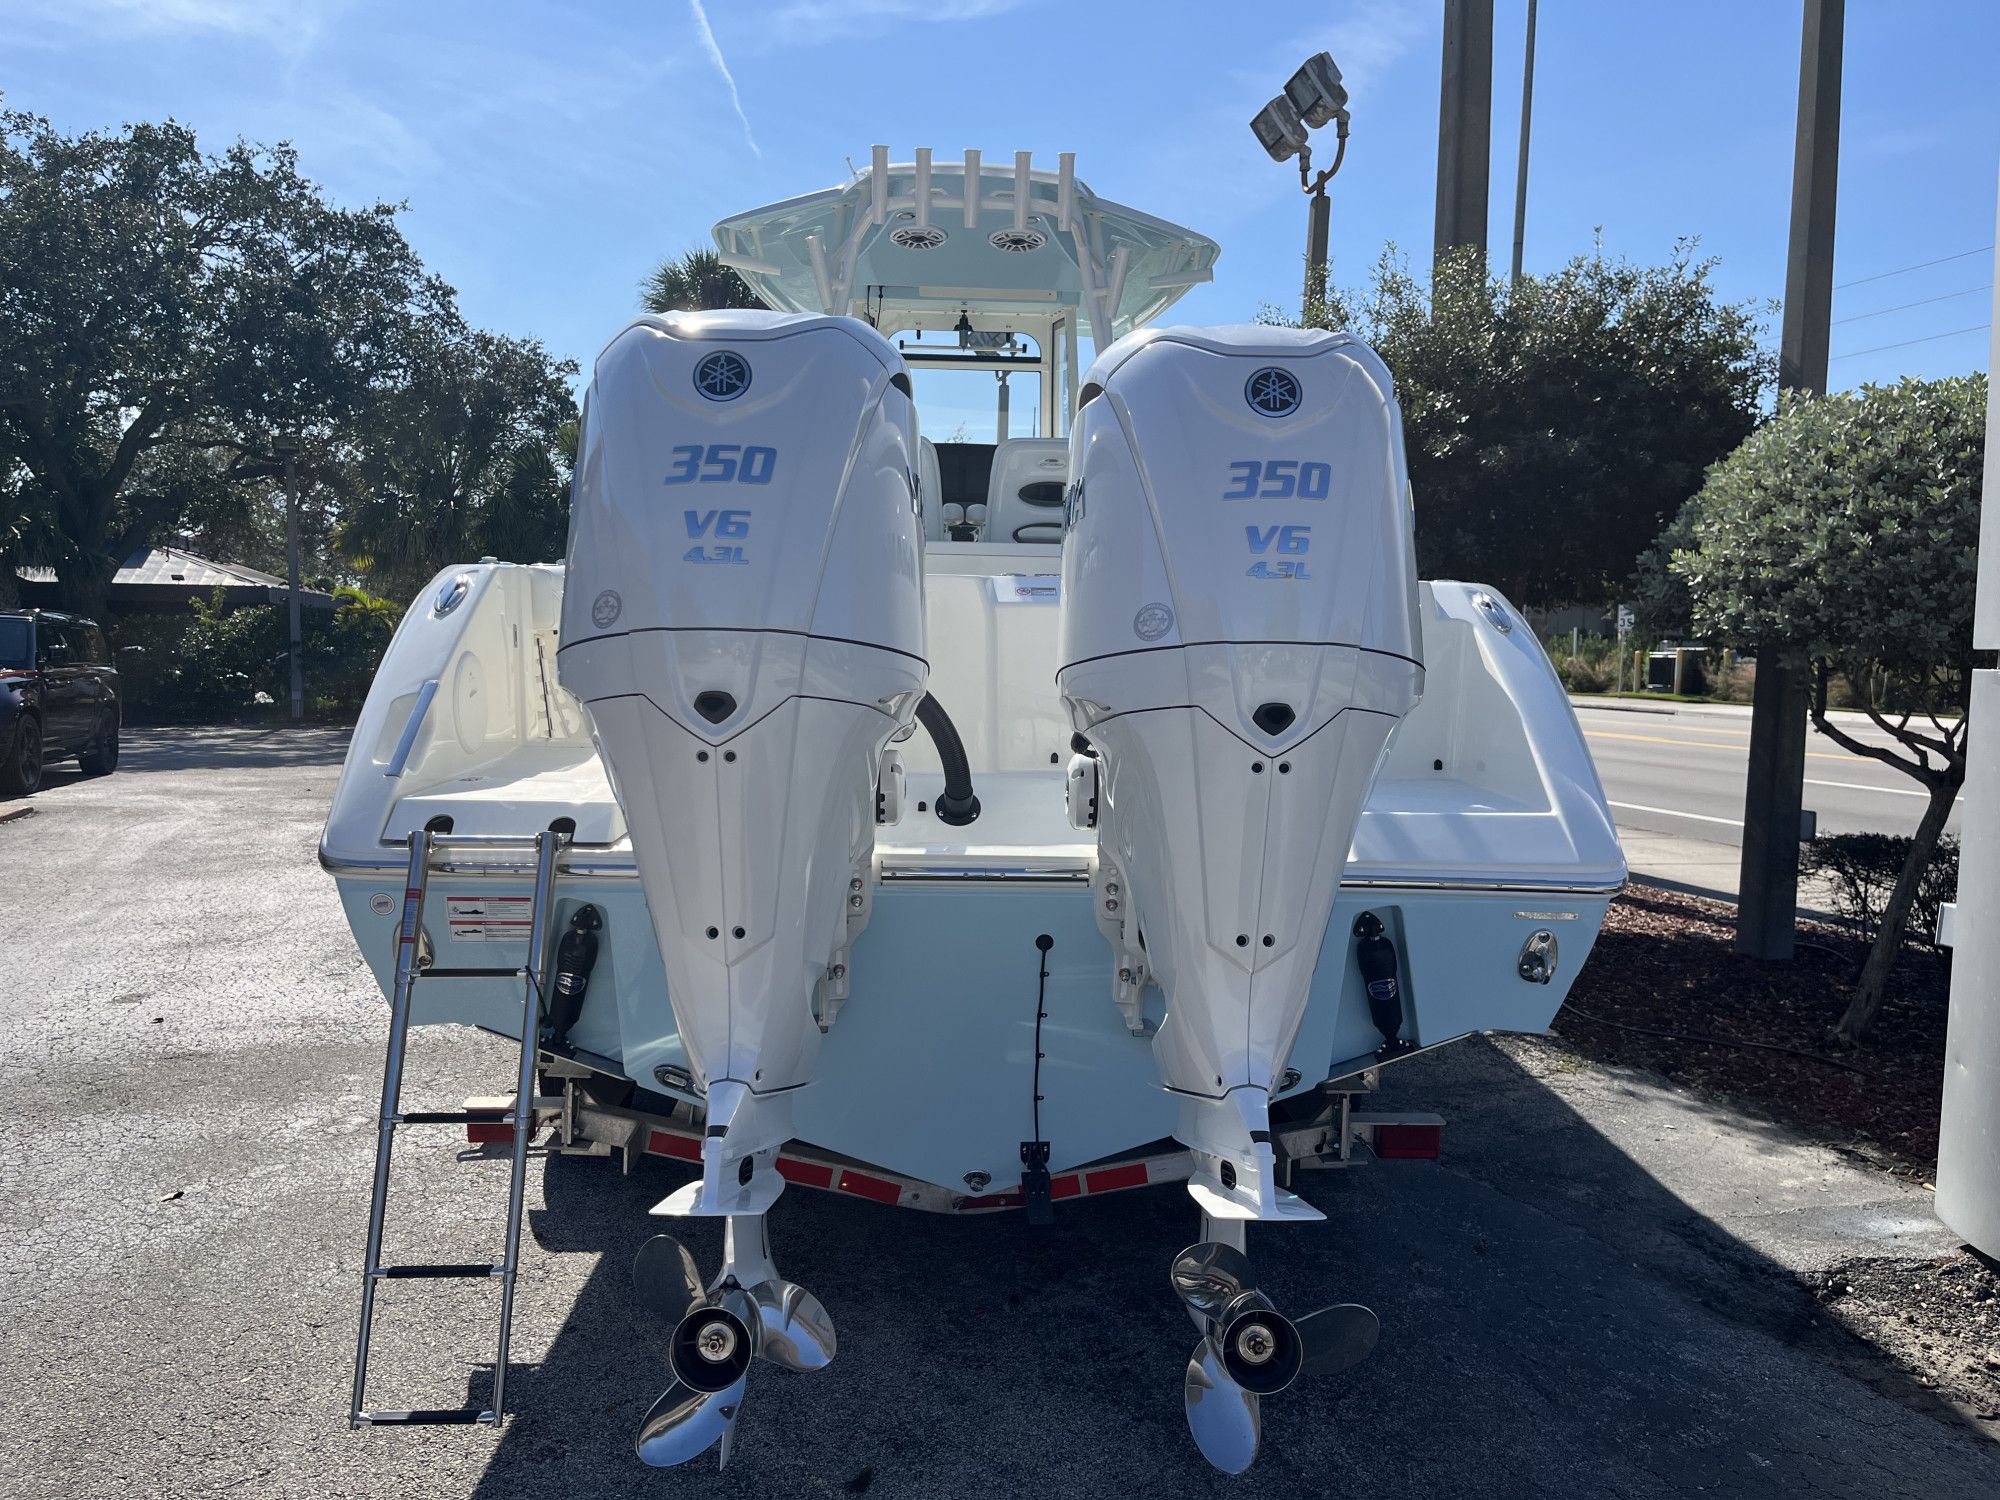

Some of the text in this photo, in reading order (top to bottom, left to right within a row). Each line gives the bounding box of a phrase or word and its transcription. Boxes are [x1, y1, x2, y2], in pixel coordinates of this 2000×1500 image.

[664, 444, 777, 486] 350
[1223, 460, 1331, 501] 350
[684, 510, 752, 540] V6
[1245, 525, 1311, 555] V6
[683, 546, 750, 565] 4.3L
[1246, 561, 1311, 580] 4.3L
